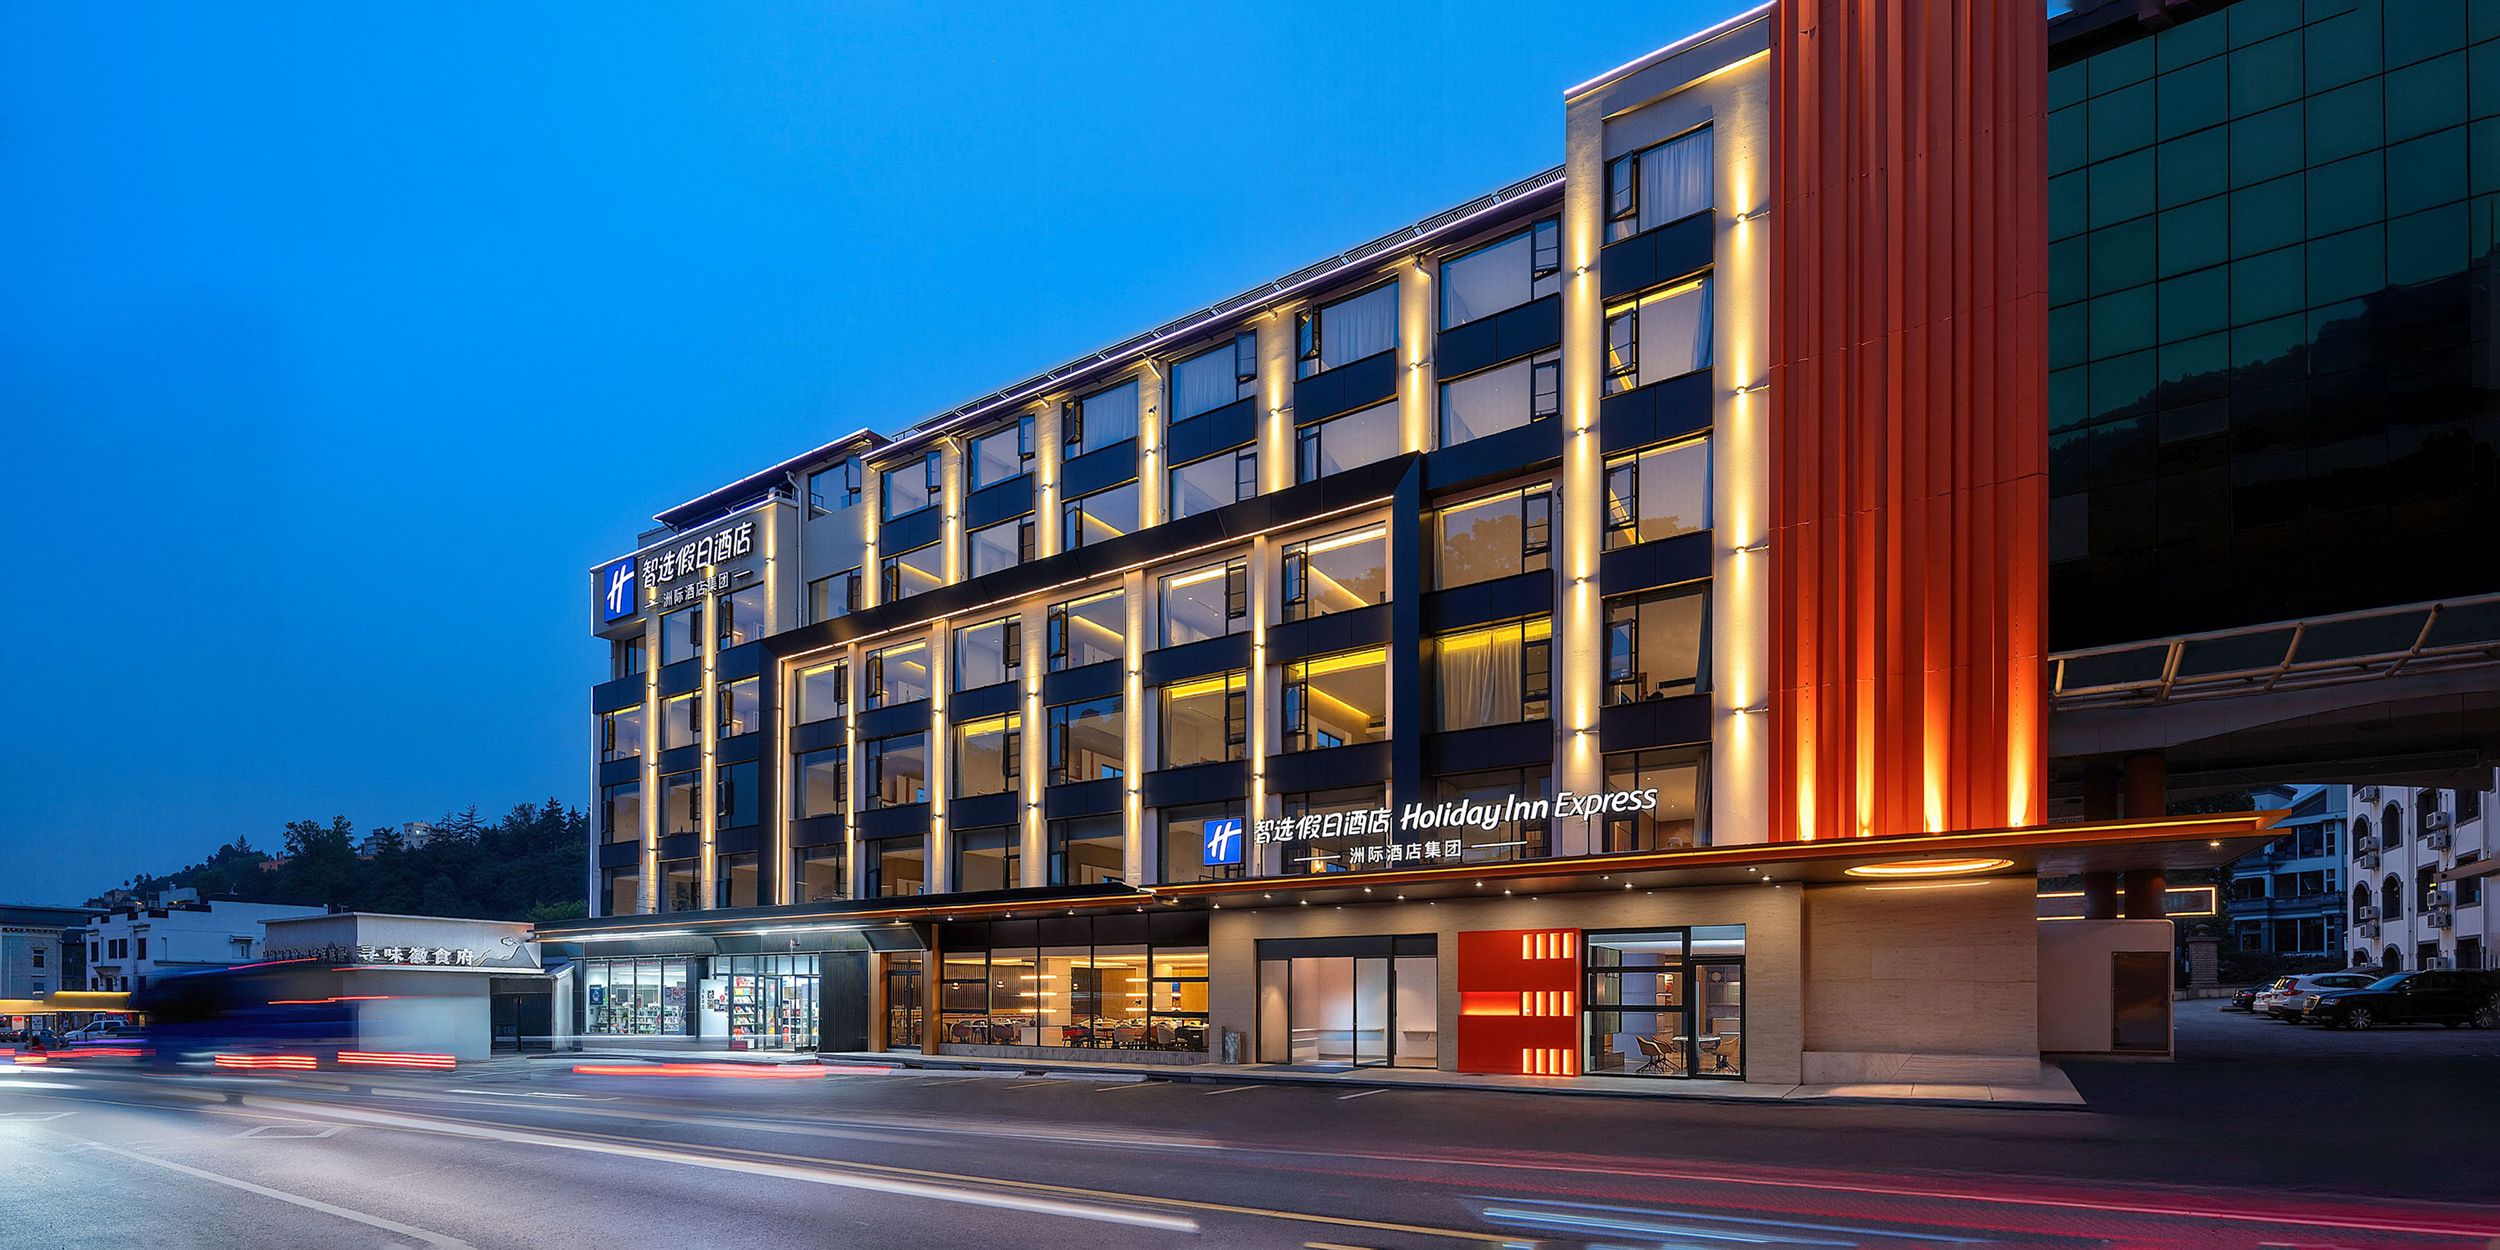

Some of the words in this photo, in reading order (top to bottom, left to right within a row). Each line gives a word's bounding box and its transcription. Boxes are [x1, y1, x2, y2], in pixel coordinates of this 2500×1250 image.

[642, 522, 753, 589] 智选假日酒店
[662, 571, 729, 608] 洲际酒店集团
[1254, 807, 1393, 845] 智选假日酒店
[1400, 798, 1502, 831] Holiday
[1504, 793, 1549, 822] Inn
[1554, 788, 1658, 821] Express
[1349, 839, 1462, 864] 洲际酒店集团
